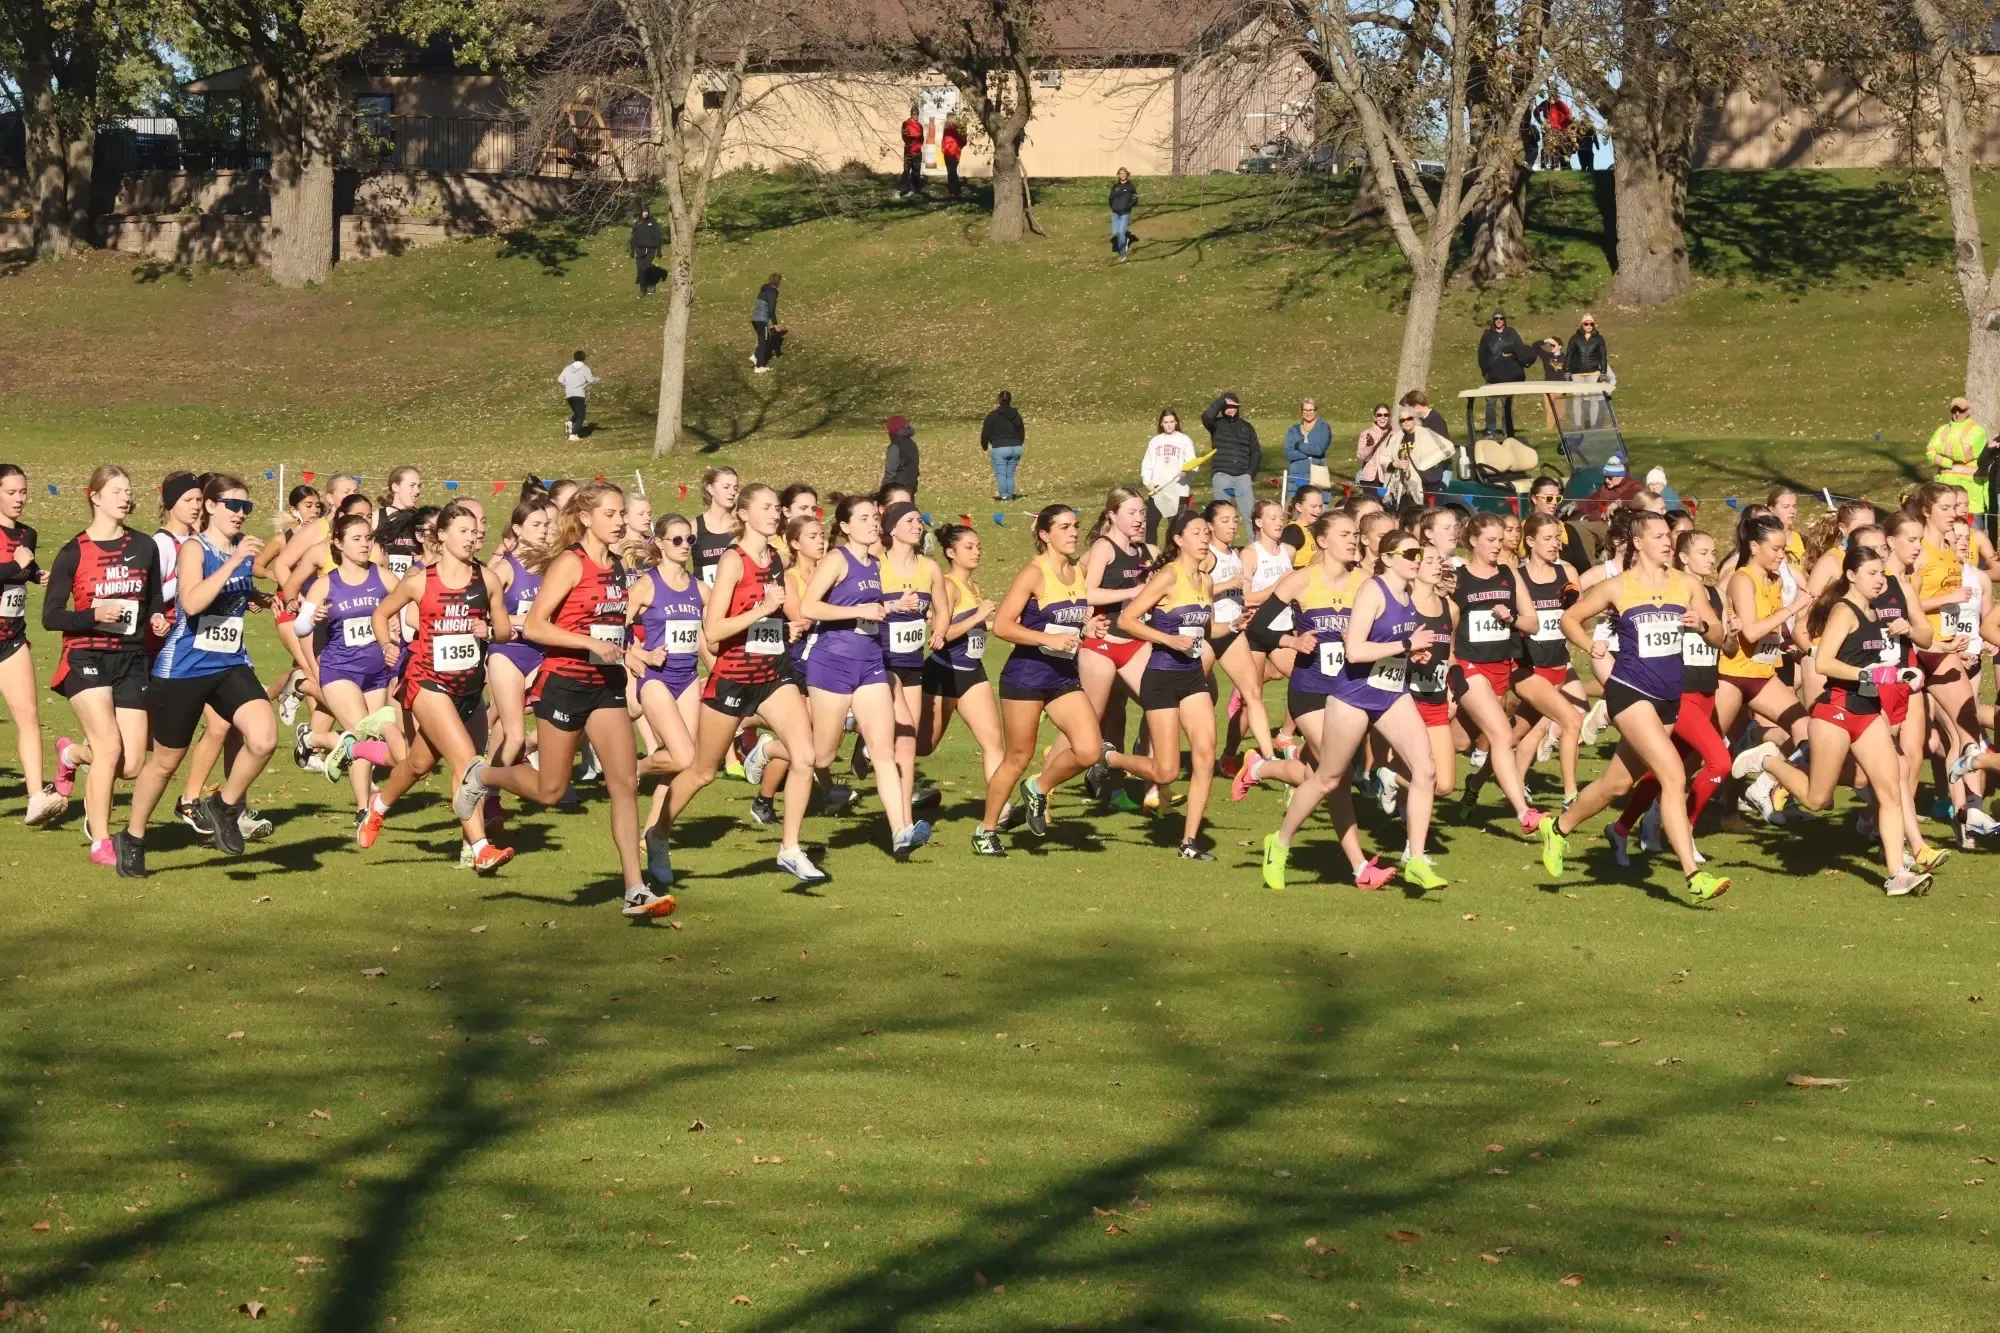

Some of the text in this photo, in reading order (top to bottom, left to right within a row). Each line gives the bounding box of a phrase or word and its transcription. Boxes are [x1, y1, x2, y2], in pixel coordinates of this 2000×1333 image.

[615, 106, 646, 115] ULTRA
[105, 566, 129, 580] MLC
[388, 562, 408, 573] 429
[95, 580, 142, 597] KNIGHTS
[605, 585, 622, 600] MLC
[858, 581, 869, 591] ST.
[520, 588, 533, 600] ST.
[1467, 592, 1479, 602] ST.
[339, 596, 381, 612] ST. KATE'S
[445, 604, 470, 617] MLC
[664, 606, 678, 616] ST.
[433, 618, 474, 632] KNIGHT
[1392, 624, 1403, 635] ST.
[1542, 618, 1561, 631] 425
[1957, 622, 1973, 633] 96
[204, 626, 238, 642] 1539
[349, 625, 373, 639] 144
[671, 629, 698, 643] 1439
[754, 627, 780, 643] 1353
[896, 628, 923, 643] 1406
[1644, 631, 1679, 647] 1397
[971, 636, 985, 650] 139
[440, 644, 475, 660] 1355
[1326, 651, 1344, 666] 14
[1378, 665, 1405, 682] 1438
[725, 695, 742, 708] MLC
